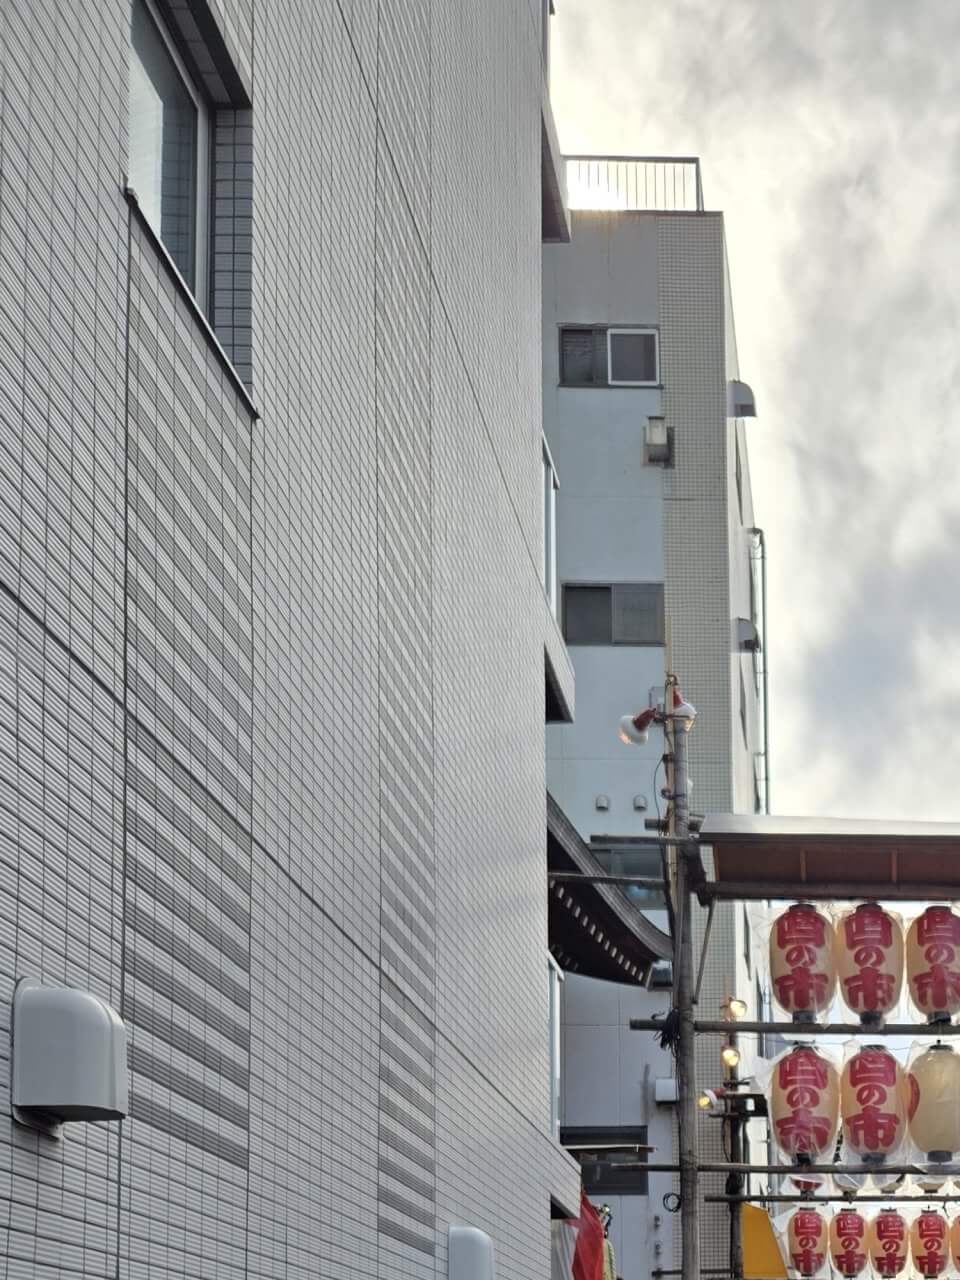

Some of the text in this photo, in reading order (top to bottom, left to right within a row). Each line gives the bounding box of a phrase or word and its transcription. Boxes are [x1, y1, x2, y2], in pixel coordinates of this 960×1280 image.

[775, 908, 829, 1010] 酉の市
[843, 907, 896, 1010] 酉の市
[776, 1050, 831, 1151] 酉の市
[846, 1049, 901, 1151] 酉の市
[791, 1210, 825, 1273] 酉の市
[835, 1212, 868, 1274] 酉の市
[874, 1213, 907, 1275] 酉の市
[915, 1213, 949, 1275] 酉の市
